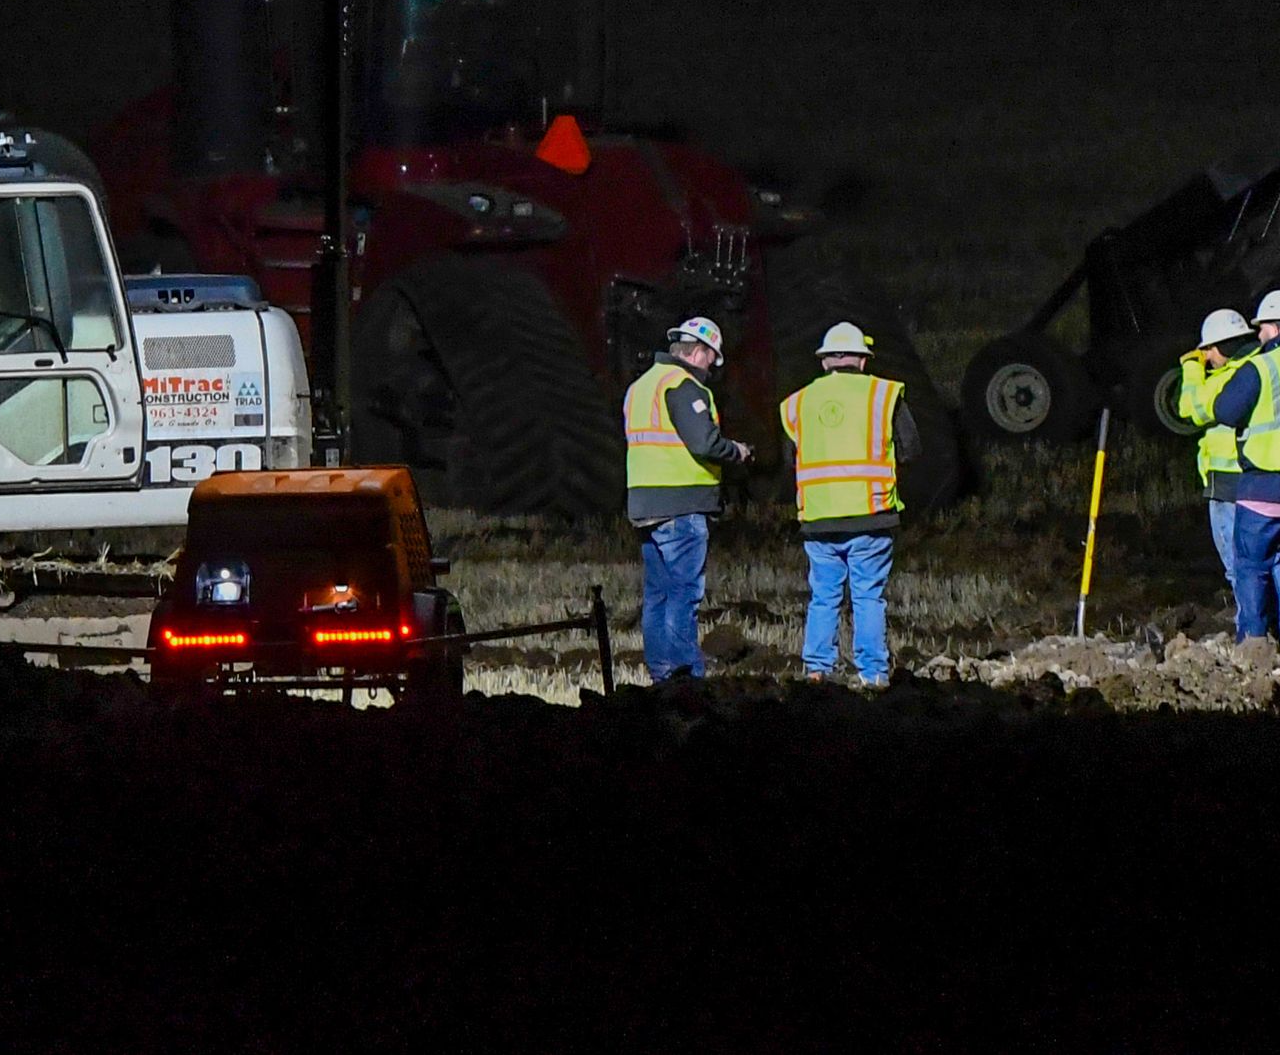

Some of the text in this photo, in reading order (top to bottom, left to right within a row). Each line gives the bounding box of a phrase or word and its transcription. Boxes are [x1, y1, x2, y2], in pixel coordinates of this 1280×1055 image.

[143, 377, 223, 393] MiTrac
[146, 393, 229, 403] ONSTRUCTION
[235, 398, 262, 406] TRIAD
[150, 407, 217, 418] 963-4324
[145, 444, 261, 483] 130
